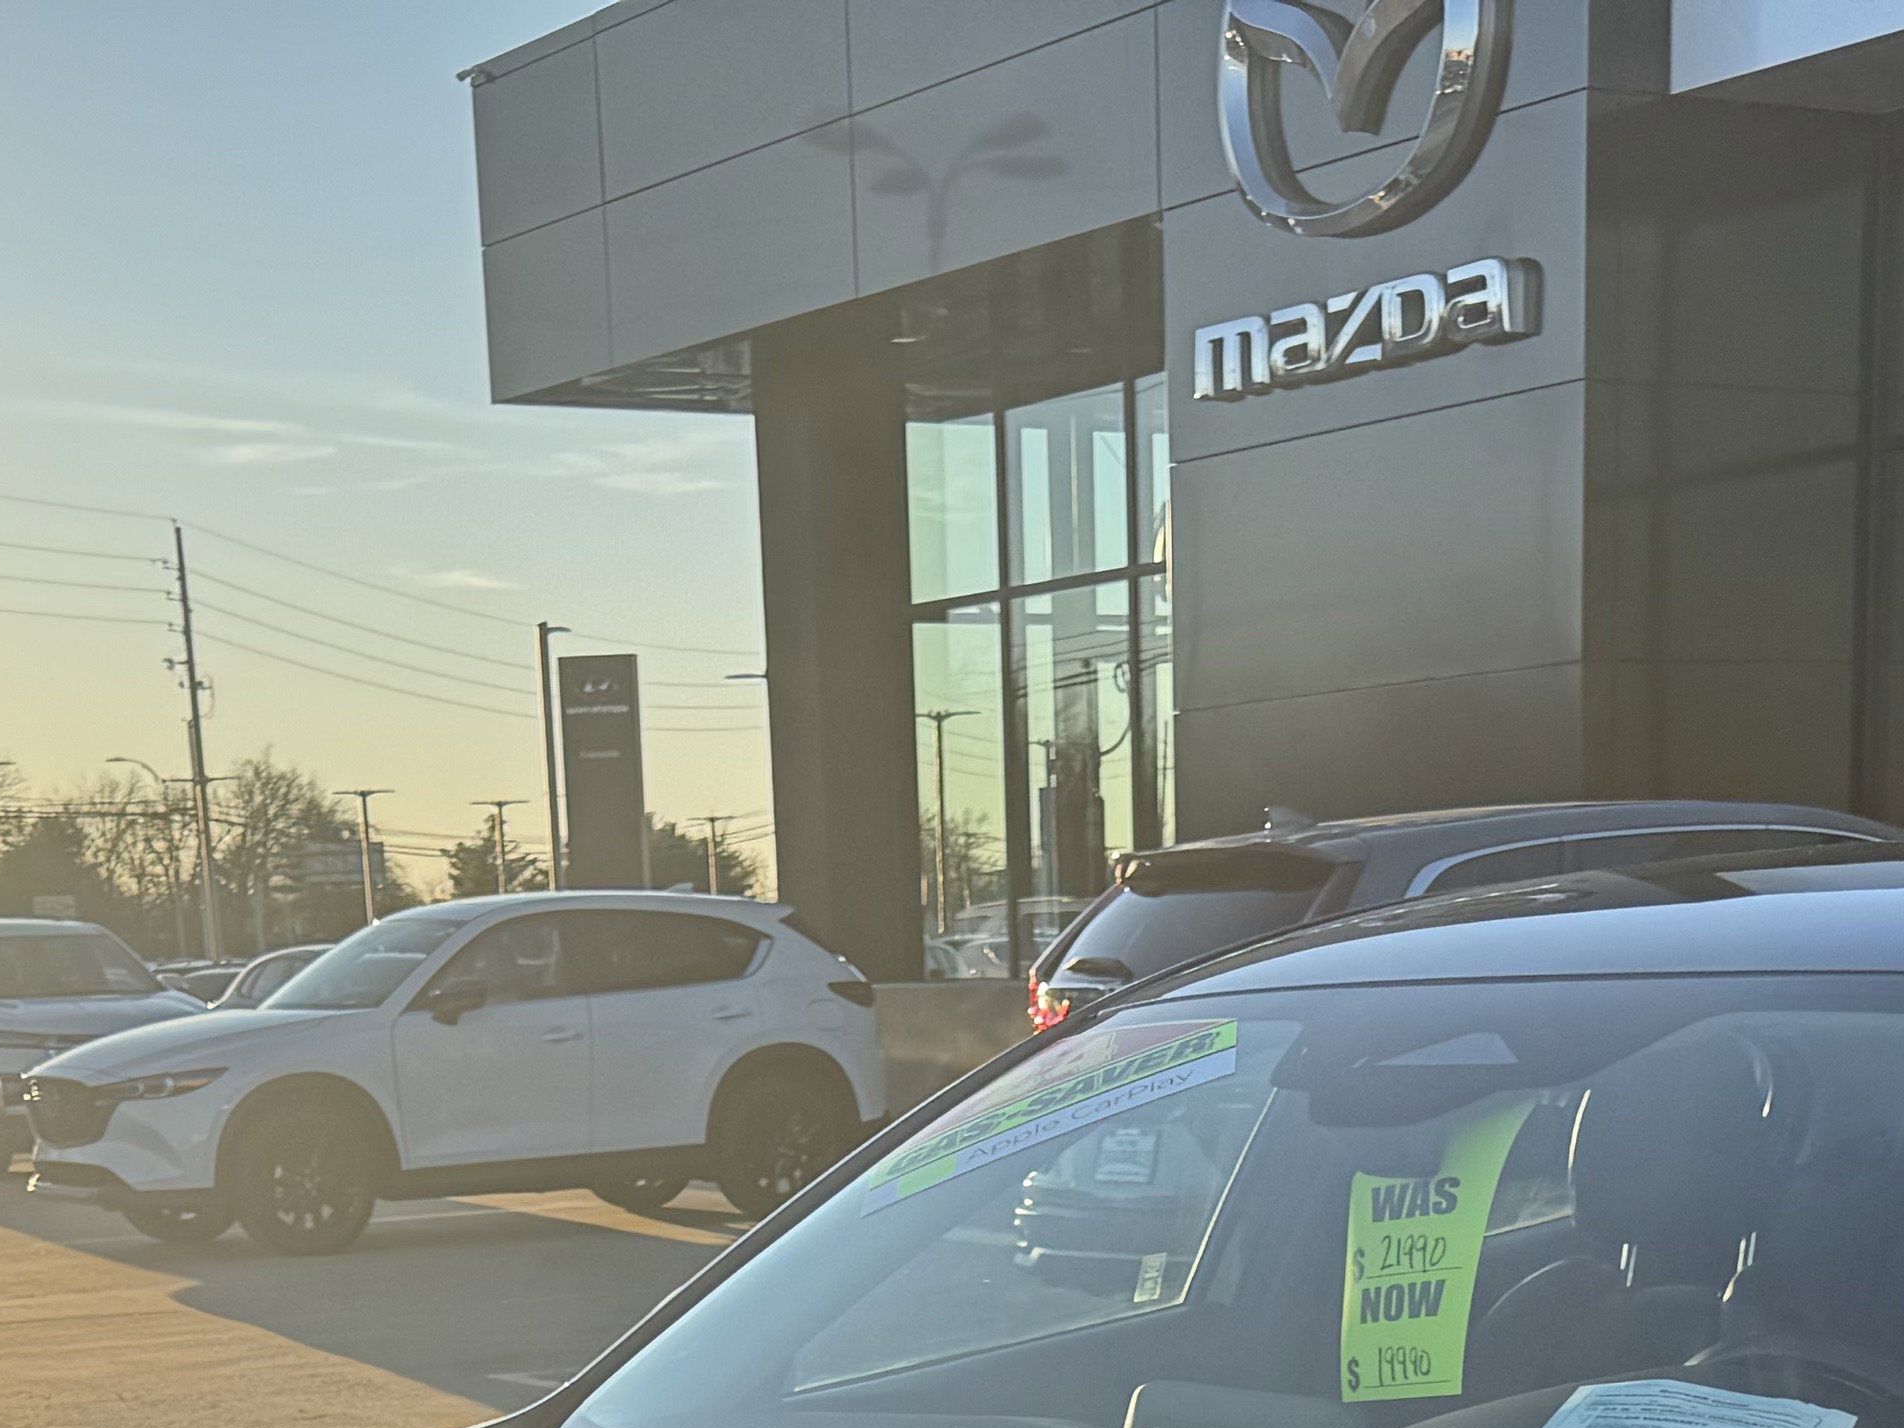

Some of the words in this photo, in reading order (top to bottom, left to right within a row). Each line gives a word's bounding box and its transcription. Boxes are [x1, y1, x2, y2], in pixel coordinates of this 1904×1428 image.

[967, 1117, 1060, 1163] Apple
[1080, 1069, 1194, 1120] CarPlay
[1370, 1176, 1461, 1223] WAS
[1380, 1234, 1446, 1273] 21990
[1359, 1279, 1446, 1325] NOW
[1378, 1346, 1431, 1387] 19990
